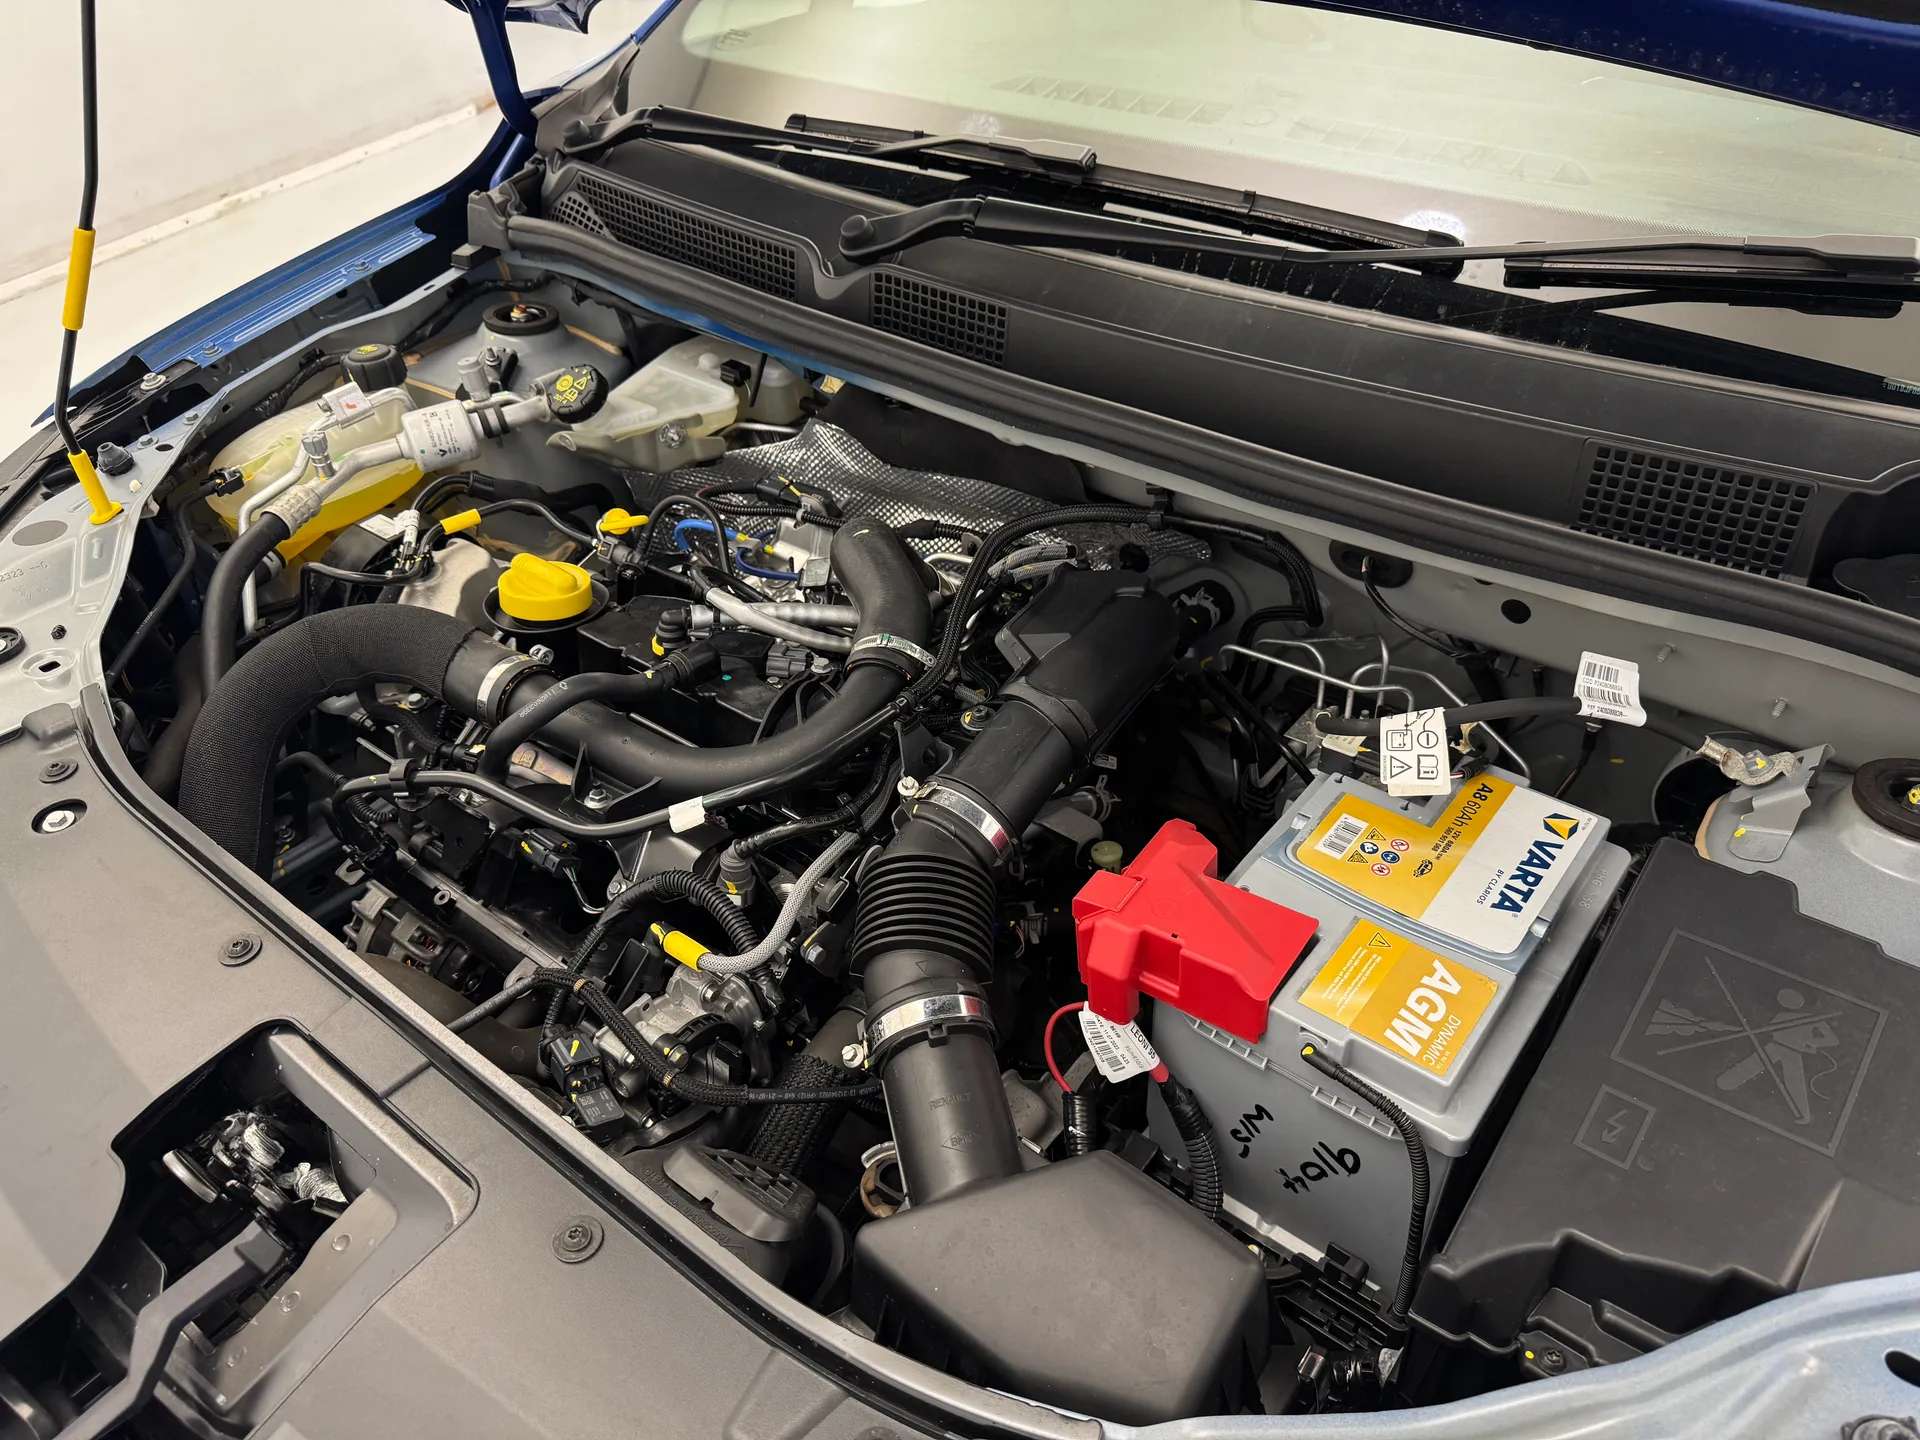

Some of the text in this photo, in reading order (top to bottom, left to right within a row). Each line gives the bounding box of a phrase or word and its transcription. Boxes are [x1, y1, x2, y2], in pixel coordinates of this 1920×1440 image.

[1473, 782, 1494, 801] A8
[1452, 800, 1480, 827] 60Ah
[1476, 869, 1504, 905] BY CLARIOS
[1490, 840, 1564, 913] VARTA
[1384, 959, 1462, 1056] AGM
[1130, 1025, 1149, 1050] LEONI
[1423, 1015, 1461, 1066] DYNAMIC
